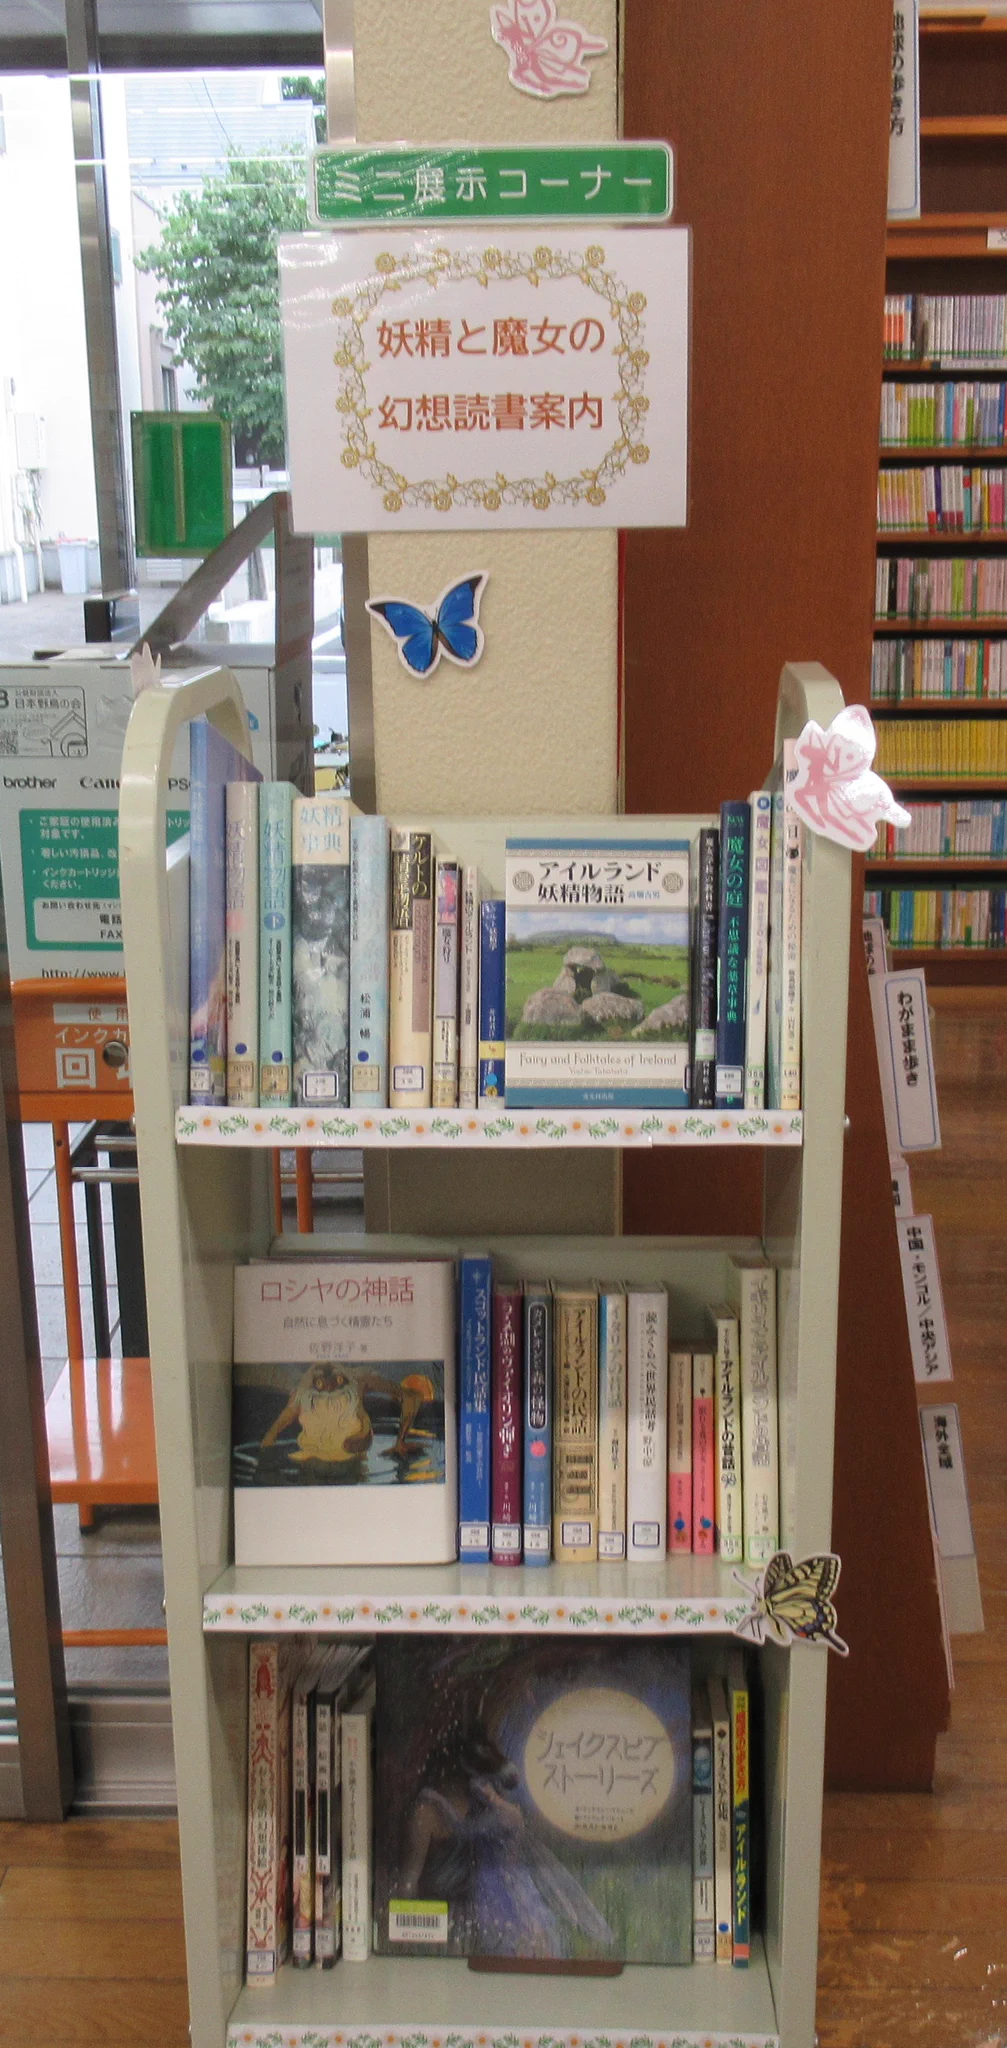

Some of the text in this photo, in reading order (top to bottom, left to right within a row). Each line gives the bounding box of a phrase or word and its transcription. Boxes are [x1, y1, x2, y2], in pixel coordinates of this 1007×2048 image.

[334, 164, 653, 204] ミニ展示コーナー
[376, 317, 606, 358] 妖精と魔女の
[378, 393, 604, 431] 幻想読書案内
[3, 775, 58, 790] brother
[79, 775, 121, 790] Can
[300, 804, 343, 828] 妖精
[301, 833, 342, 854] 事典
[411, 835, 428, 897] ケルトの
[539, 861, 662, 882] アイルランド
[726, 836, 745, 909] 魔女の庭
[538, 884, 625, 904] 妖精物語
[100, 929, 123, 939] FAX
[727, 916, 741, 1024] 不思議な薬草事典
[896, 990, 920, 1087] わがまま歩き
[519, 1053, 677, 1068] Fairy and Folktales of Ireland
[260, 1275, 415, 1305] ロシヤの神話
[283, 1314, 393, 1329] 自然に息づく精霊たち
[474, 1288, 487, 1413] スコットランド民話集
[571, 1307, 587, 1435] アイルランドの民話
[721, 1360, 736, 1470] アイルランドの昔話
[537, 1730, 666, 1762] シェイクスピア
[543, 1764, 660, 1796] ストーリーズ
[735, 1823, 747, 1926] アイルランド
